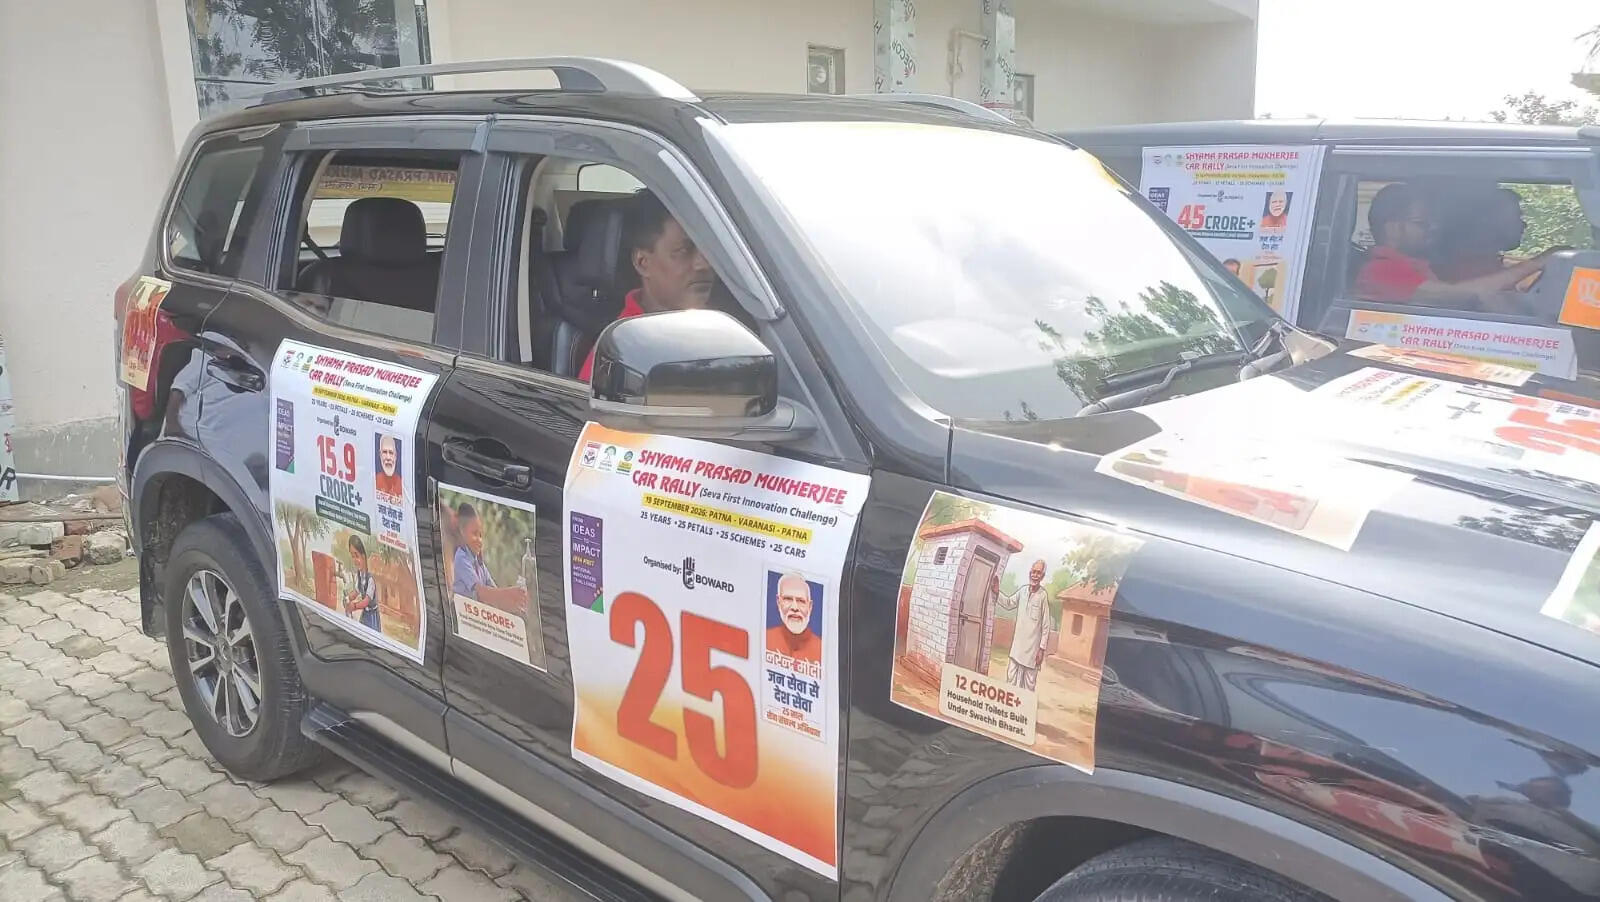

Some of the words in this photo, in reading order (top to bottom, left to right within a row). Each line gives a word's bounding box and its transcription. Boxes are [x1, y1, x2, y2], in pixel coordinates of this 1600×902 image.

[1185, 152, 1216, 160] SHYAMA
[1218, 152, 1249, 160] PRASAD
[1251, 152, 1299, 160] MUKHERJEE
[1202, 162, 1225, 171] RALLY
[1177, 204, 1206, 229] 45
[1204, 215, 1256, 231] CRORE+
[1400, 336, 1419, 346] CAR
[1422, 338, 1454, 350] RALLY
[1402, 324, 1444, 337] SHYAMA
[1446, 330, 1490, 341] PRASAD
[1492, 335, 1559, 349] MUKHERJEE
[308, 369, 324, 383] CAR
[324, 372, 345, 387] RALLY
[314, 354, 344, 370] SHYAMA
[344, 361, 375, 377] PRASAD
[373, 368, 422, 388] MUKHERJEE
[316, 434, 356, 484] 15.9
[319, 474, 363, 507] CRORE+
[638, 450, 693, 473] SHYAMA
[695, 460, 752, 485] PRASAD
[754, 472, 848, 505] MUKHERJEE
[632, 470, 658, 489] CAR
[660, 476, 701, 498] RALLY
[700, 487, 721, 500] (Seva
[722, 492, 741, 504] First
[742, 496, 788, 515] Innovation
[789, 507, 838, 527] Challenge)
[573, 524, 596, 538] IDEAS
[653, 497, 690, 513] SEPTEMBER
[709, 510, 732, 522] PATNA
[738, 517, 776, 534] VARANASI
[781, 528, 808, 540] PATNA
[640, 511, 648, 519] 25
[650, 512, 672, 525] YEARS
[687, 522, 713, 536] PETALS
[730, 532, 766, 549] SCHEMES
[784, 545, 807, 559] CARS
[572, 542, 601, 558] IMPACT
[643, 555, 672, 571] Organised
[695, 573, 735, 593] BOWARD
[464, 601, 479, 616] 15.9
[480, 609, 516, 629] CRORE+
[609, 590, 759, 790] 25
[766, 669, 786, 687] जन
[786, 673, 808, 694] सेवा
[808, 680, 820, 698] से
[955, 674, 967, 690] 12
[970, 680, 1022, 707] CRORE+
[773, 685, 790, 706] देश
[791, 692, 813, 713] सेवा
[946, 689, 983, 709] Household
[984, 702, 1009, 718] Toilets
[1009, 711, 1028, 725] Built
[947, 702, 968, 715] Under
[969, 710, 997, 727] Swachh
[998, 720, 1026, 736] Bharat.
